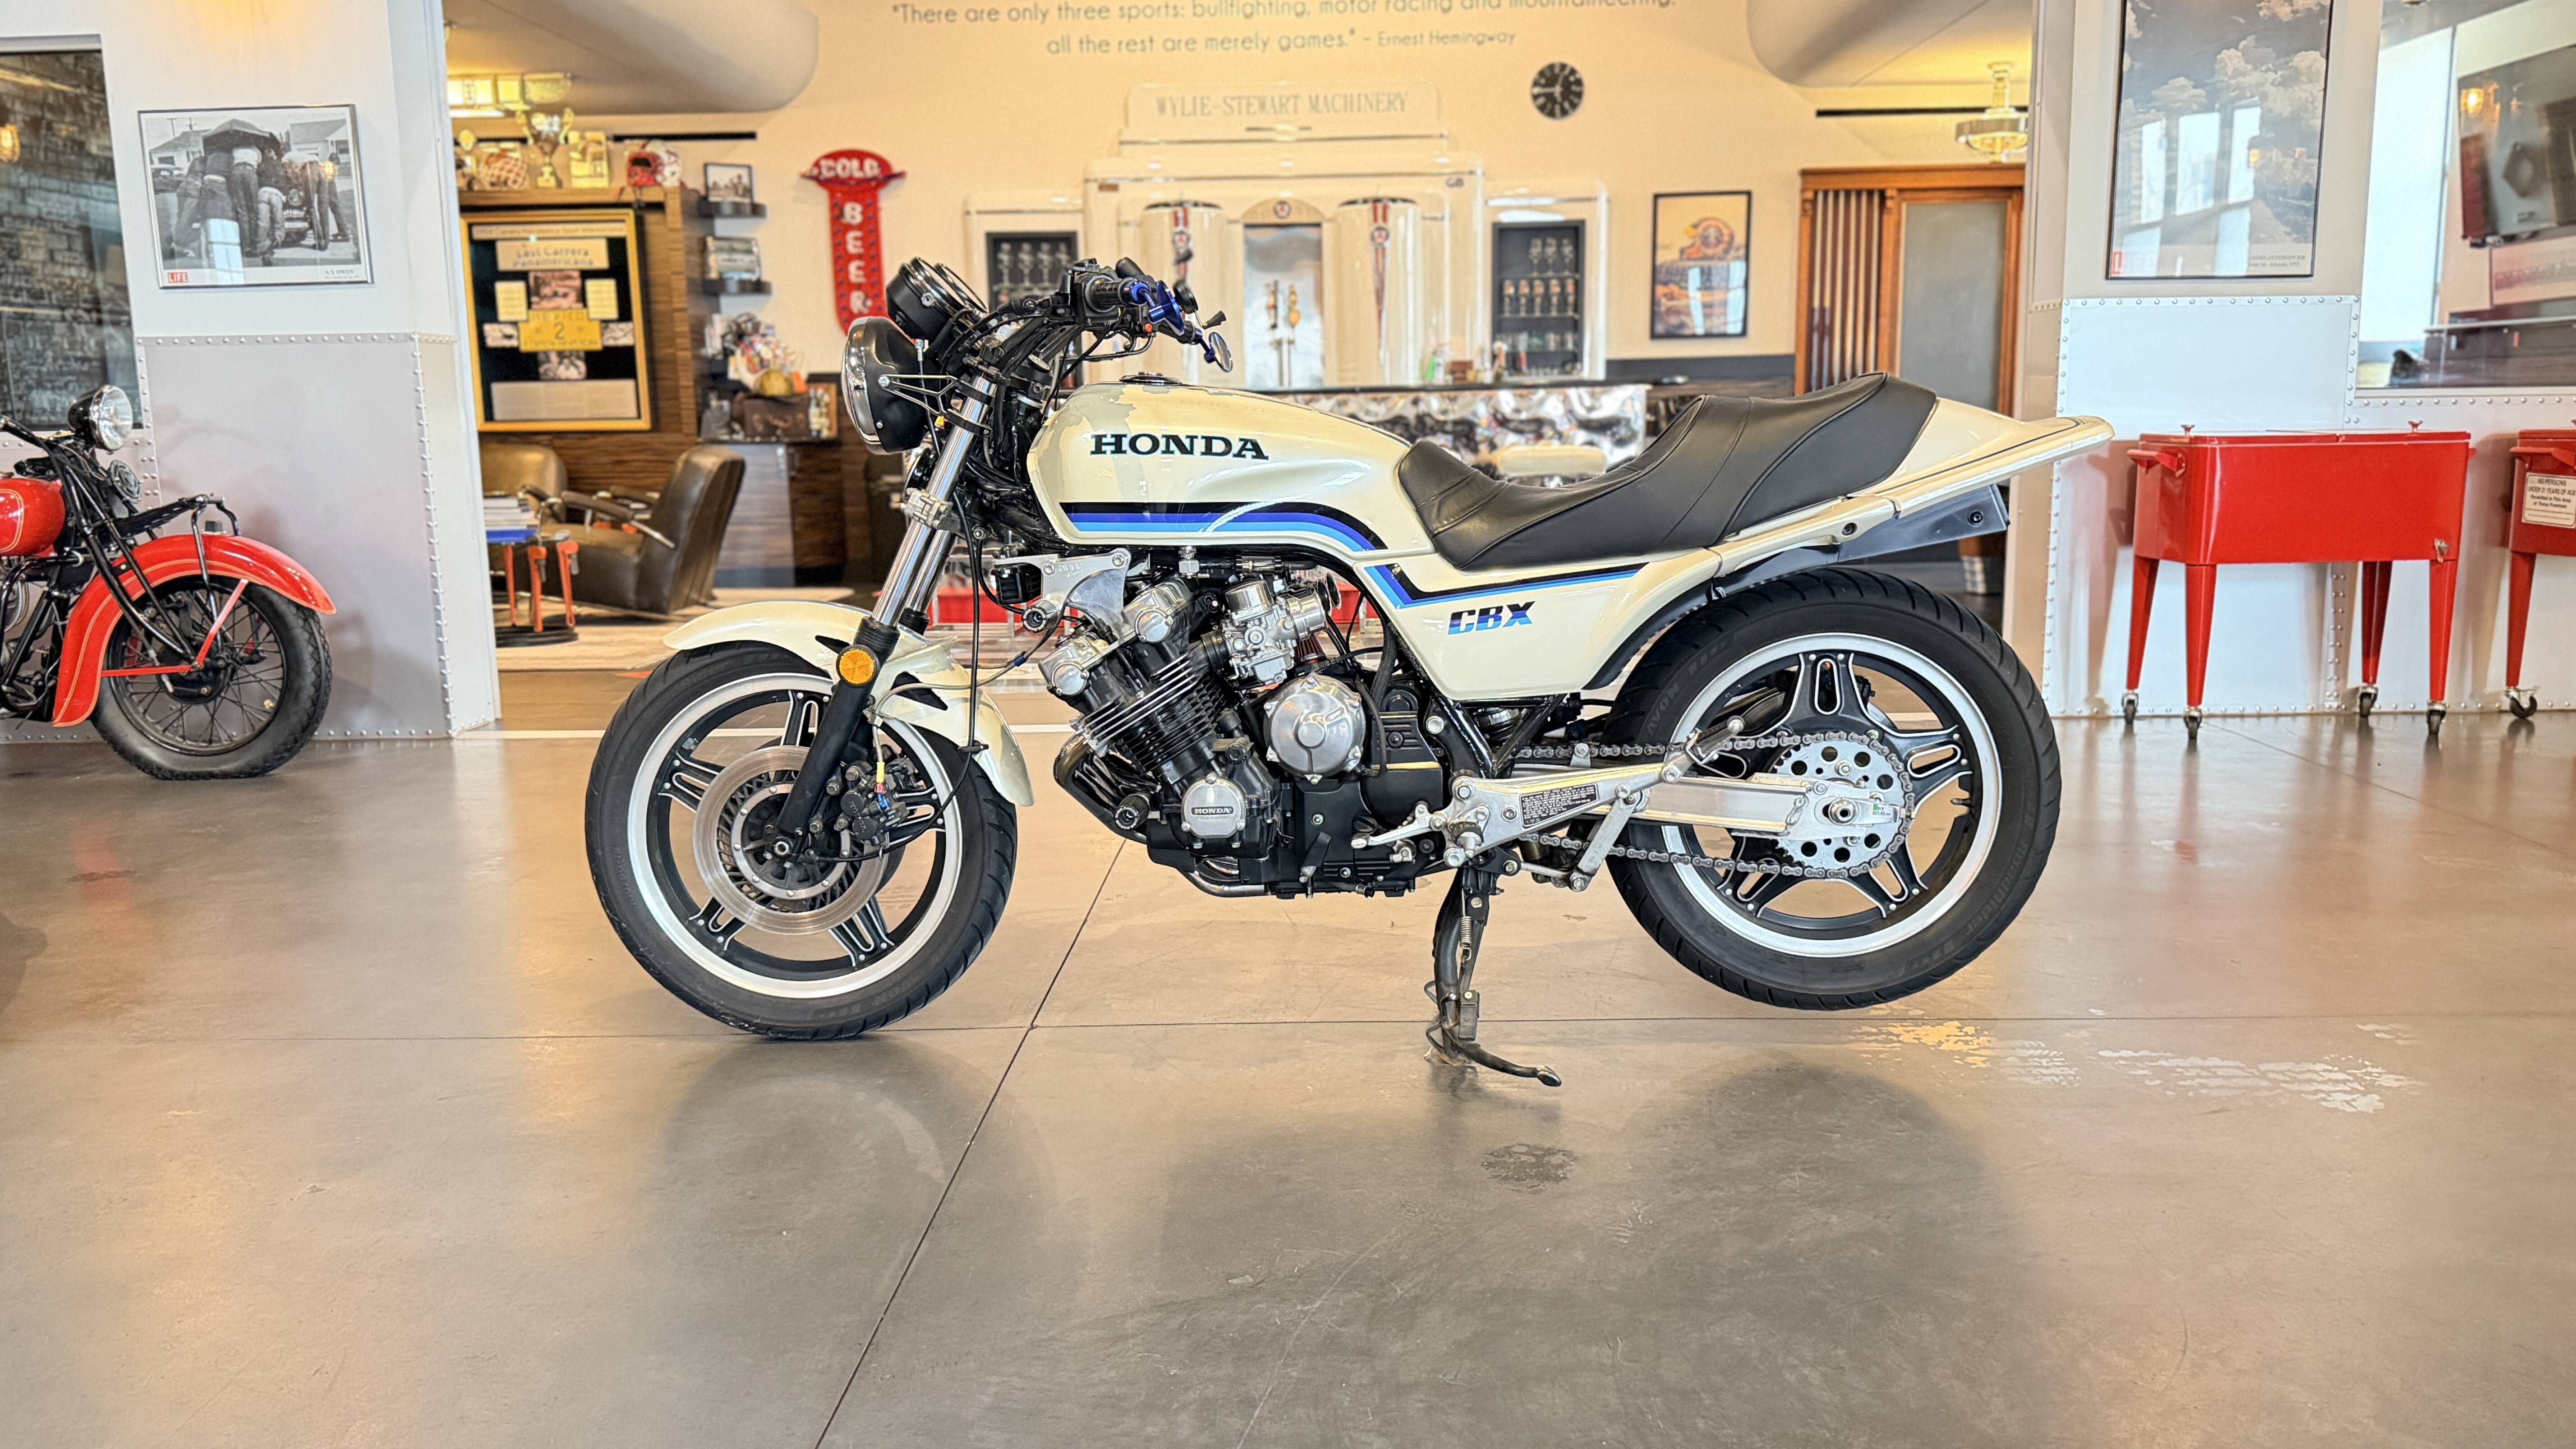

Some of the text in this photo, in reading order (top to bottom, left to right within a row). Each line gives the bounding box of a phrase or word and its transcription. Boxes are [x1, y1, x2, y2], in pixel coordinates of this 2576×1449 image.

[965, 8, 1000, 22] are
[1007, 1, 1049, 24] only
[1058, 1, 1110, 20] three
[1118, 3, 1185, 22] sports:
[1320, 0, 1376, 14] motor
[1385, 0, 1453, 13] racing
[1046, 35, 1071, 54] all
[1079, 33, 1110, 53] the
[1118, 35, 1154, 53] rest
[1163, 37, 1197, 52] are
[1205, 30, 1270, 53] merely
[1378, 31, 1424, 46] Ernest
[1430, 31, 1517, 45] Hemingway
[1155, 91, 1407, 116] WYLIE-STEWART MACHINERY
[818, 157, 882, 179] COLD
[842, 201, 873, 315] BEER
[169, 272, 188, 283] LIFE
[1090, 433, 1270, 461] HONDA
[1448, 601, 1536, 635] CBX
[1647, 681, 1680, 737] AVON
